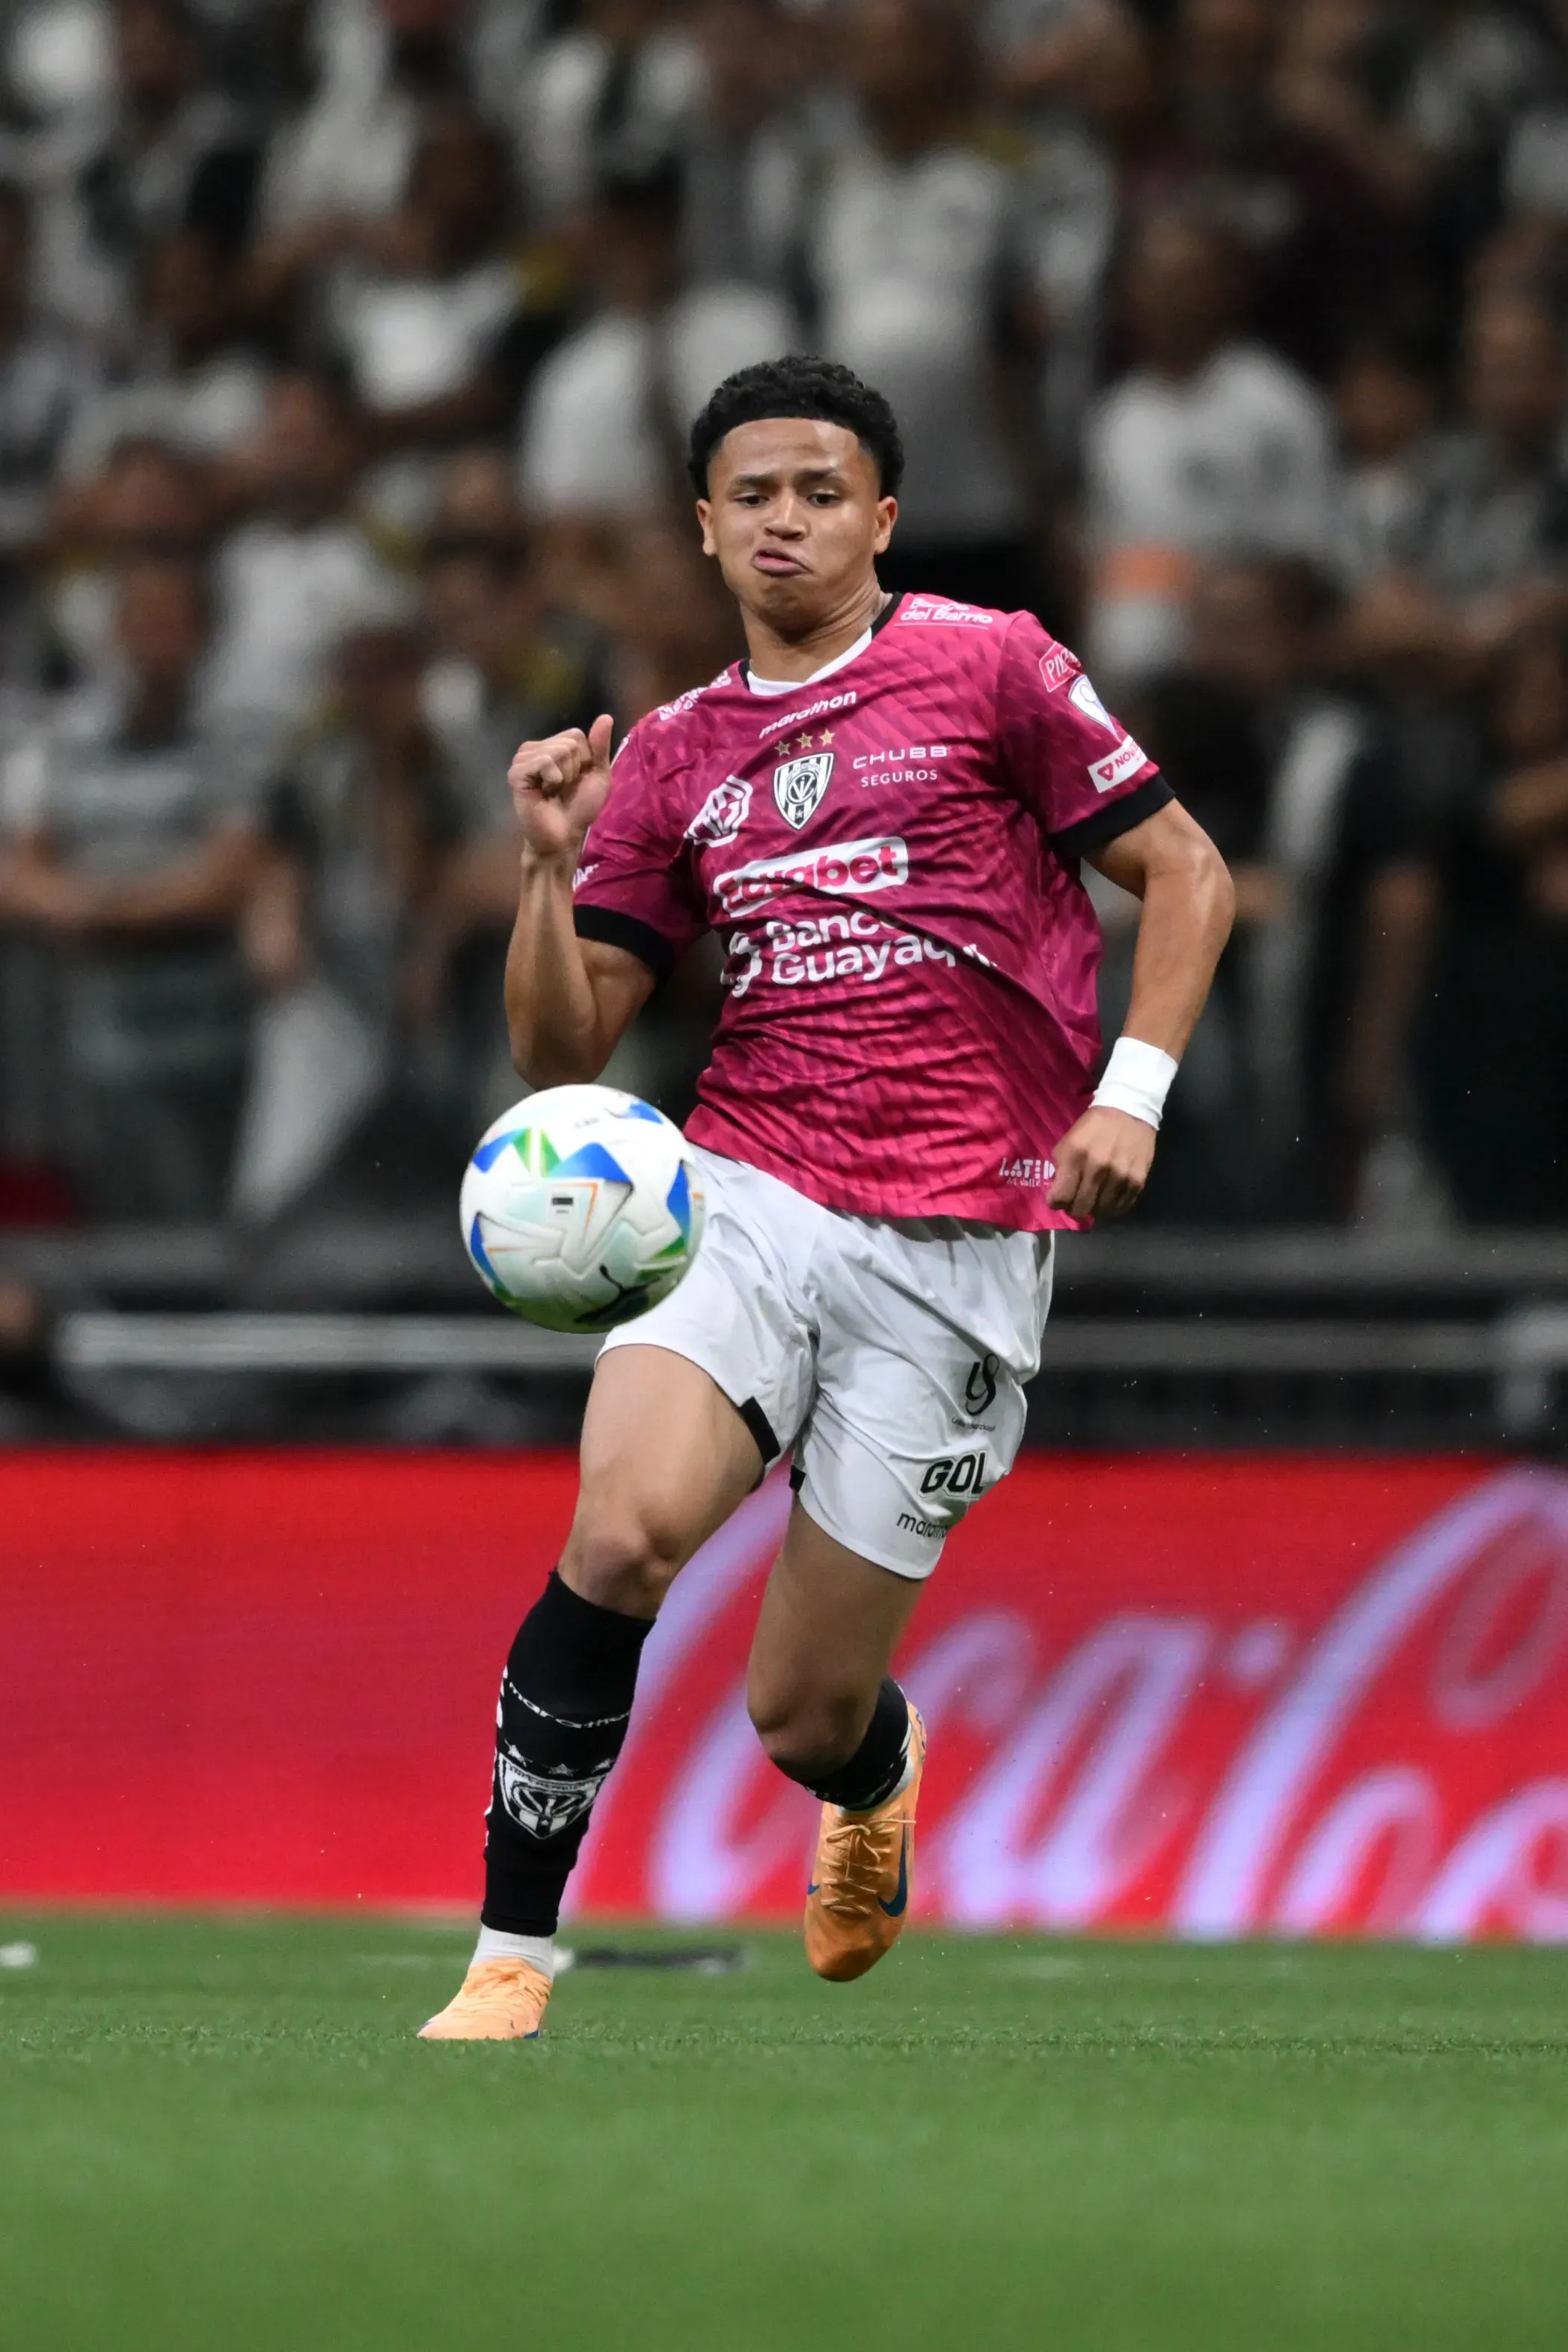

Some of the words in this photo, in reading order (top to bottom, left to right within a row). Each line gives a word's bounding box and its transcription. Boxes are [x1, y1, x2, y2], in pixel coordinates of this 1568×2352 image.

[900, 608, 932, 621] del
[932, 609, 993, 624] Barrio
[759, 690, 857, 739] marathon
[853, 746, 947, 769] CHUBB
[861, 769, 938, 788] SEGUROS
[766, 910, 898, 952] Banc
[920, 1452, 987, 1494] GOL
